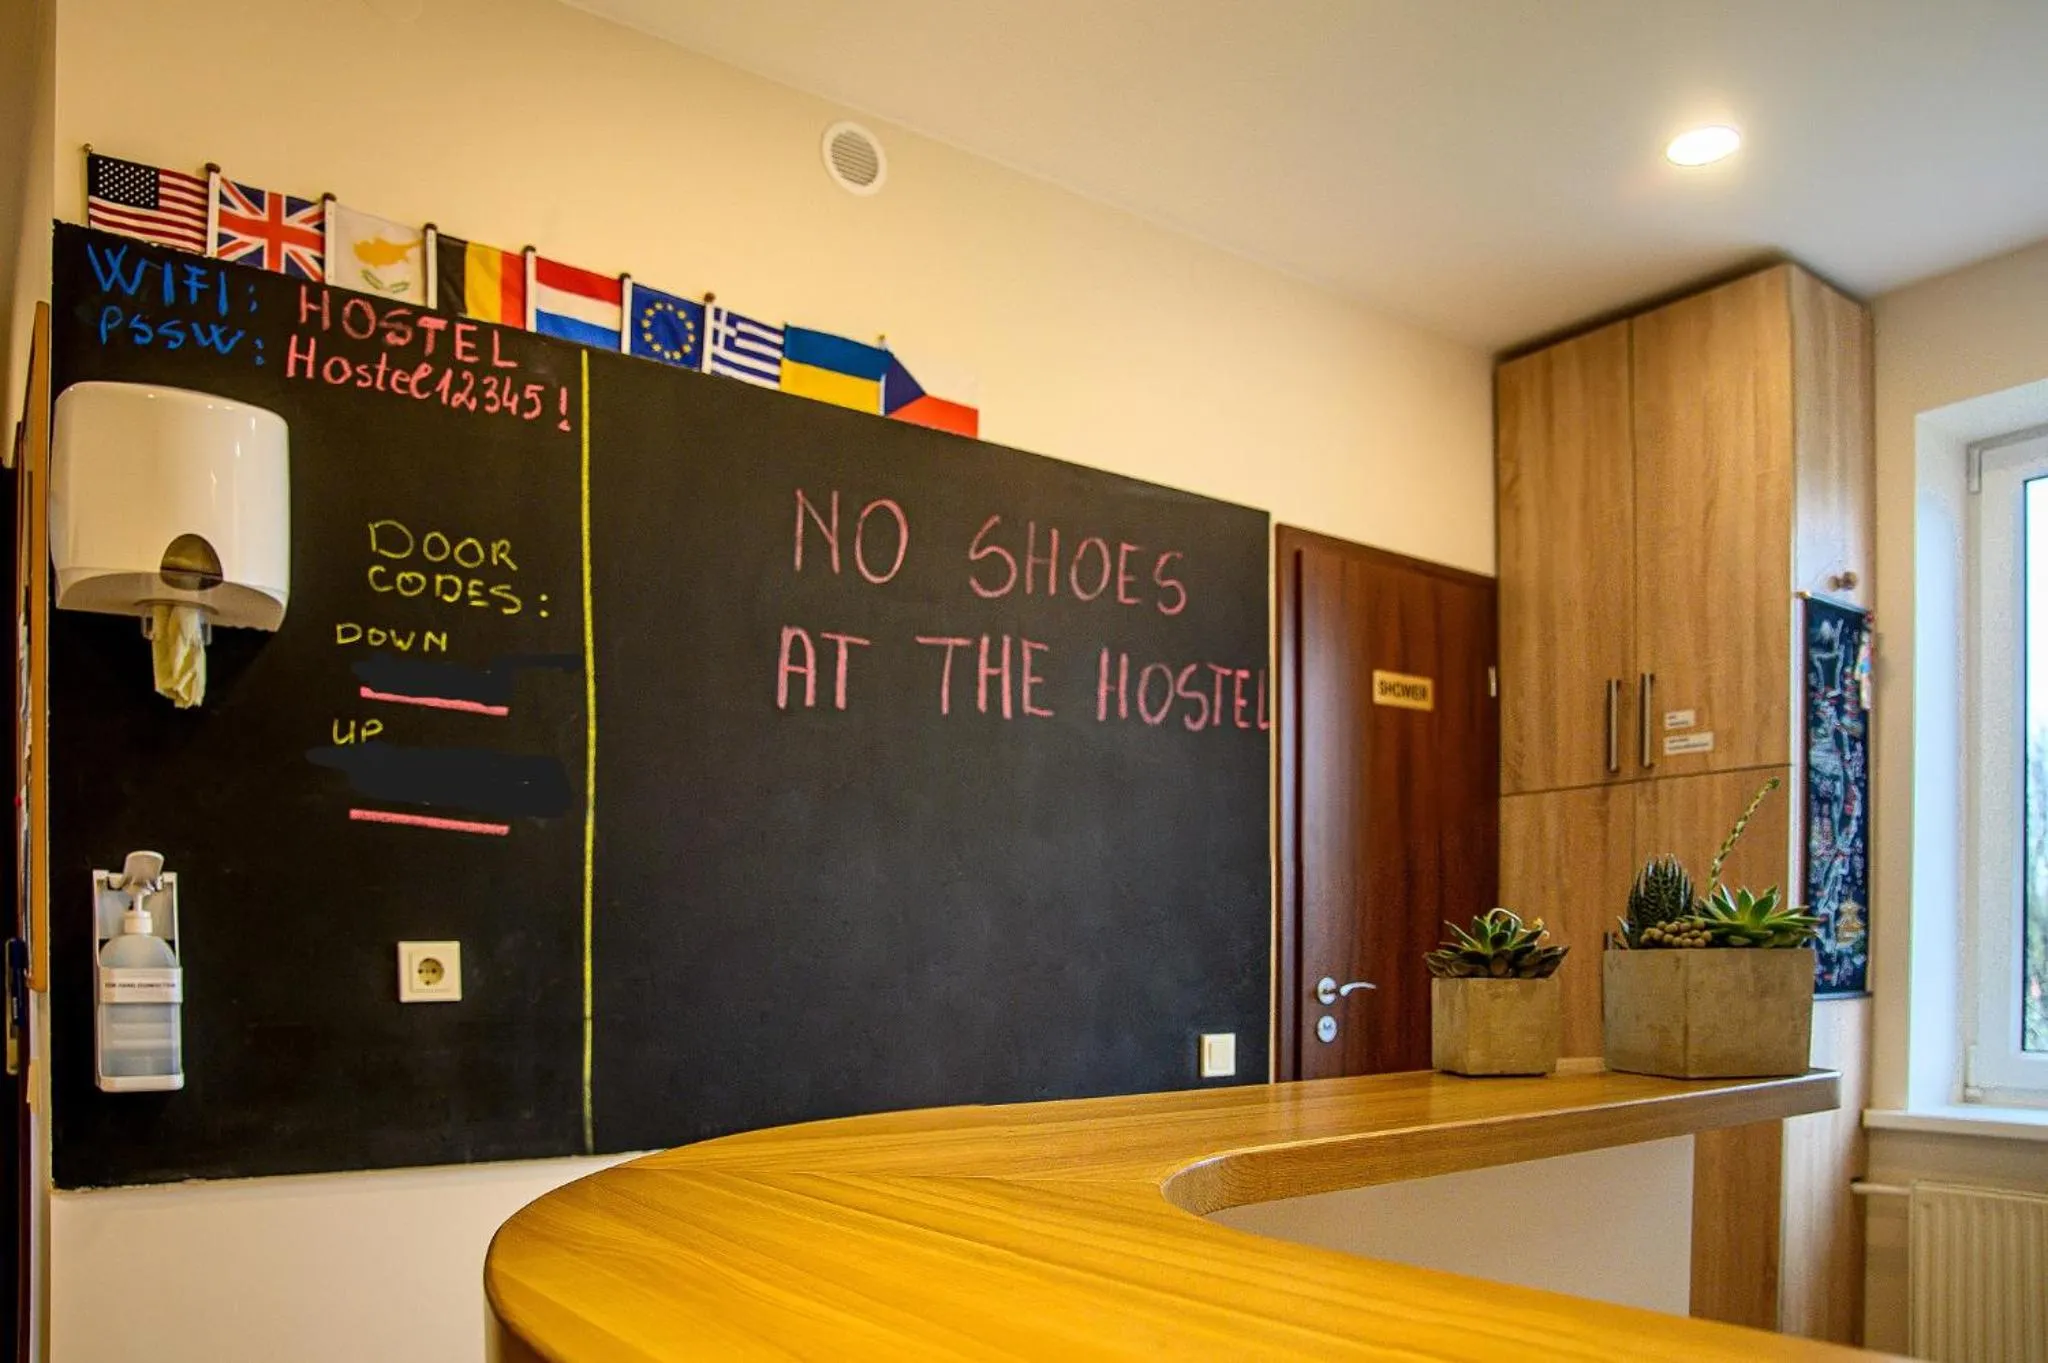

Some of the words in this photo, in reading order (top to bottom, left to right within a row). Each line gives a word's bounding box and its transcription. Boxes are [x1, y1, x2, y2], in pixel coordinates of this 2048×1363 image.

[87, 243, 258, 316] WIFI:
[298, 283, 519, 369] HOSTEL
[367, 519, 519, 572] DOOR
[794, 487, 909, 585] NO
[968, 512, 1188, 616] SHOES
[368, 564, 550, 618] CODES:
[335, 622, 449, 653] DOWN
[776, 625, 871, 711] AT
[914, 632, 1056, 721] THE
[1096, 646, 1271, 732] HOSTEL
[331, 717, 384, 745] UP
